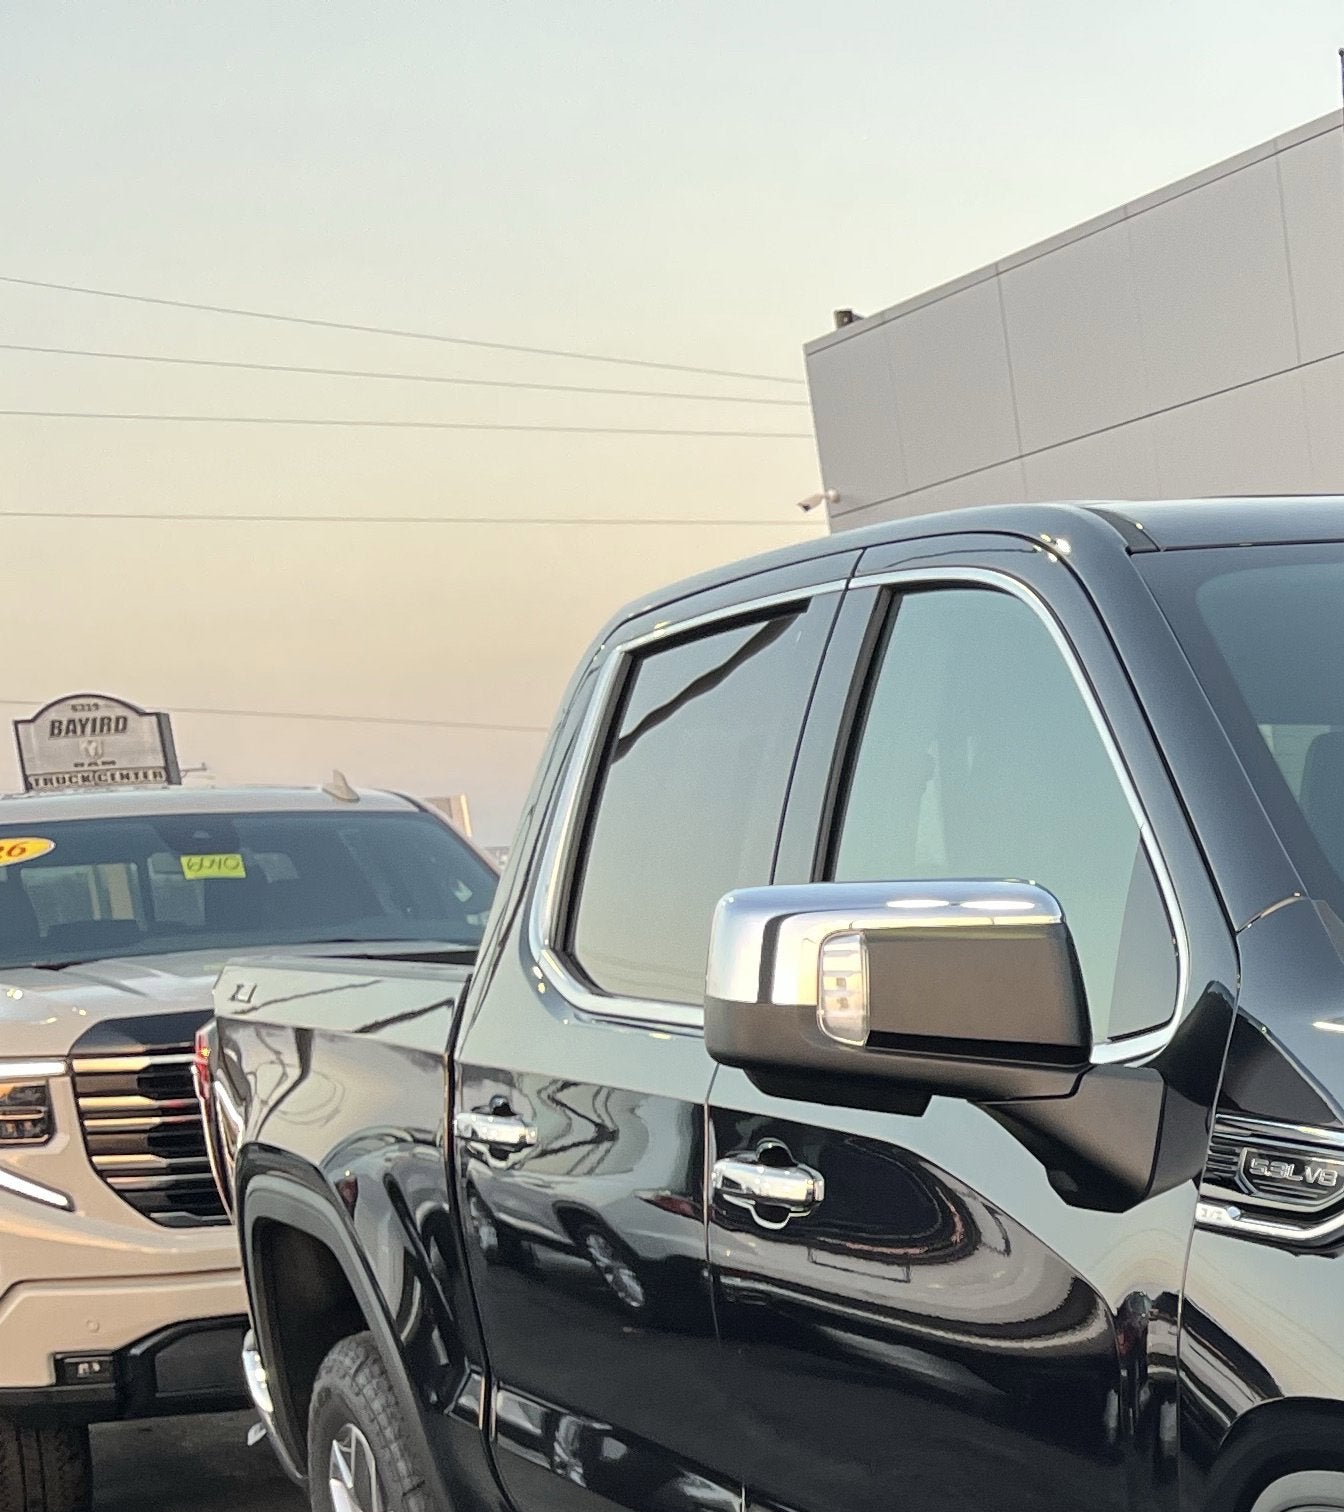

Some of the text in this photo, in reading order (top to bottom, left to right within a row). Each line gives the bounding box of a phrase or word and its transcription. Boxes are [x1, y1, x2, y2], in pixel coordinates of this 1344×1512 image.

[50, 714, 128, 738] BAYIRD
[33, 770, 163, 787] TRUCK CENTER
[1305, 1166, 1338, 1187] V8
